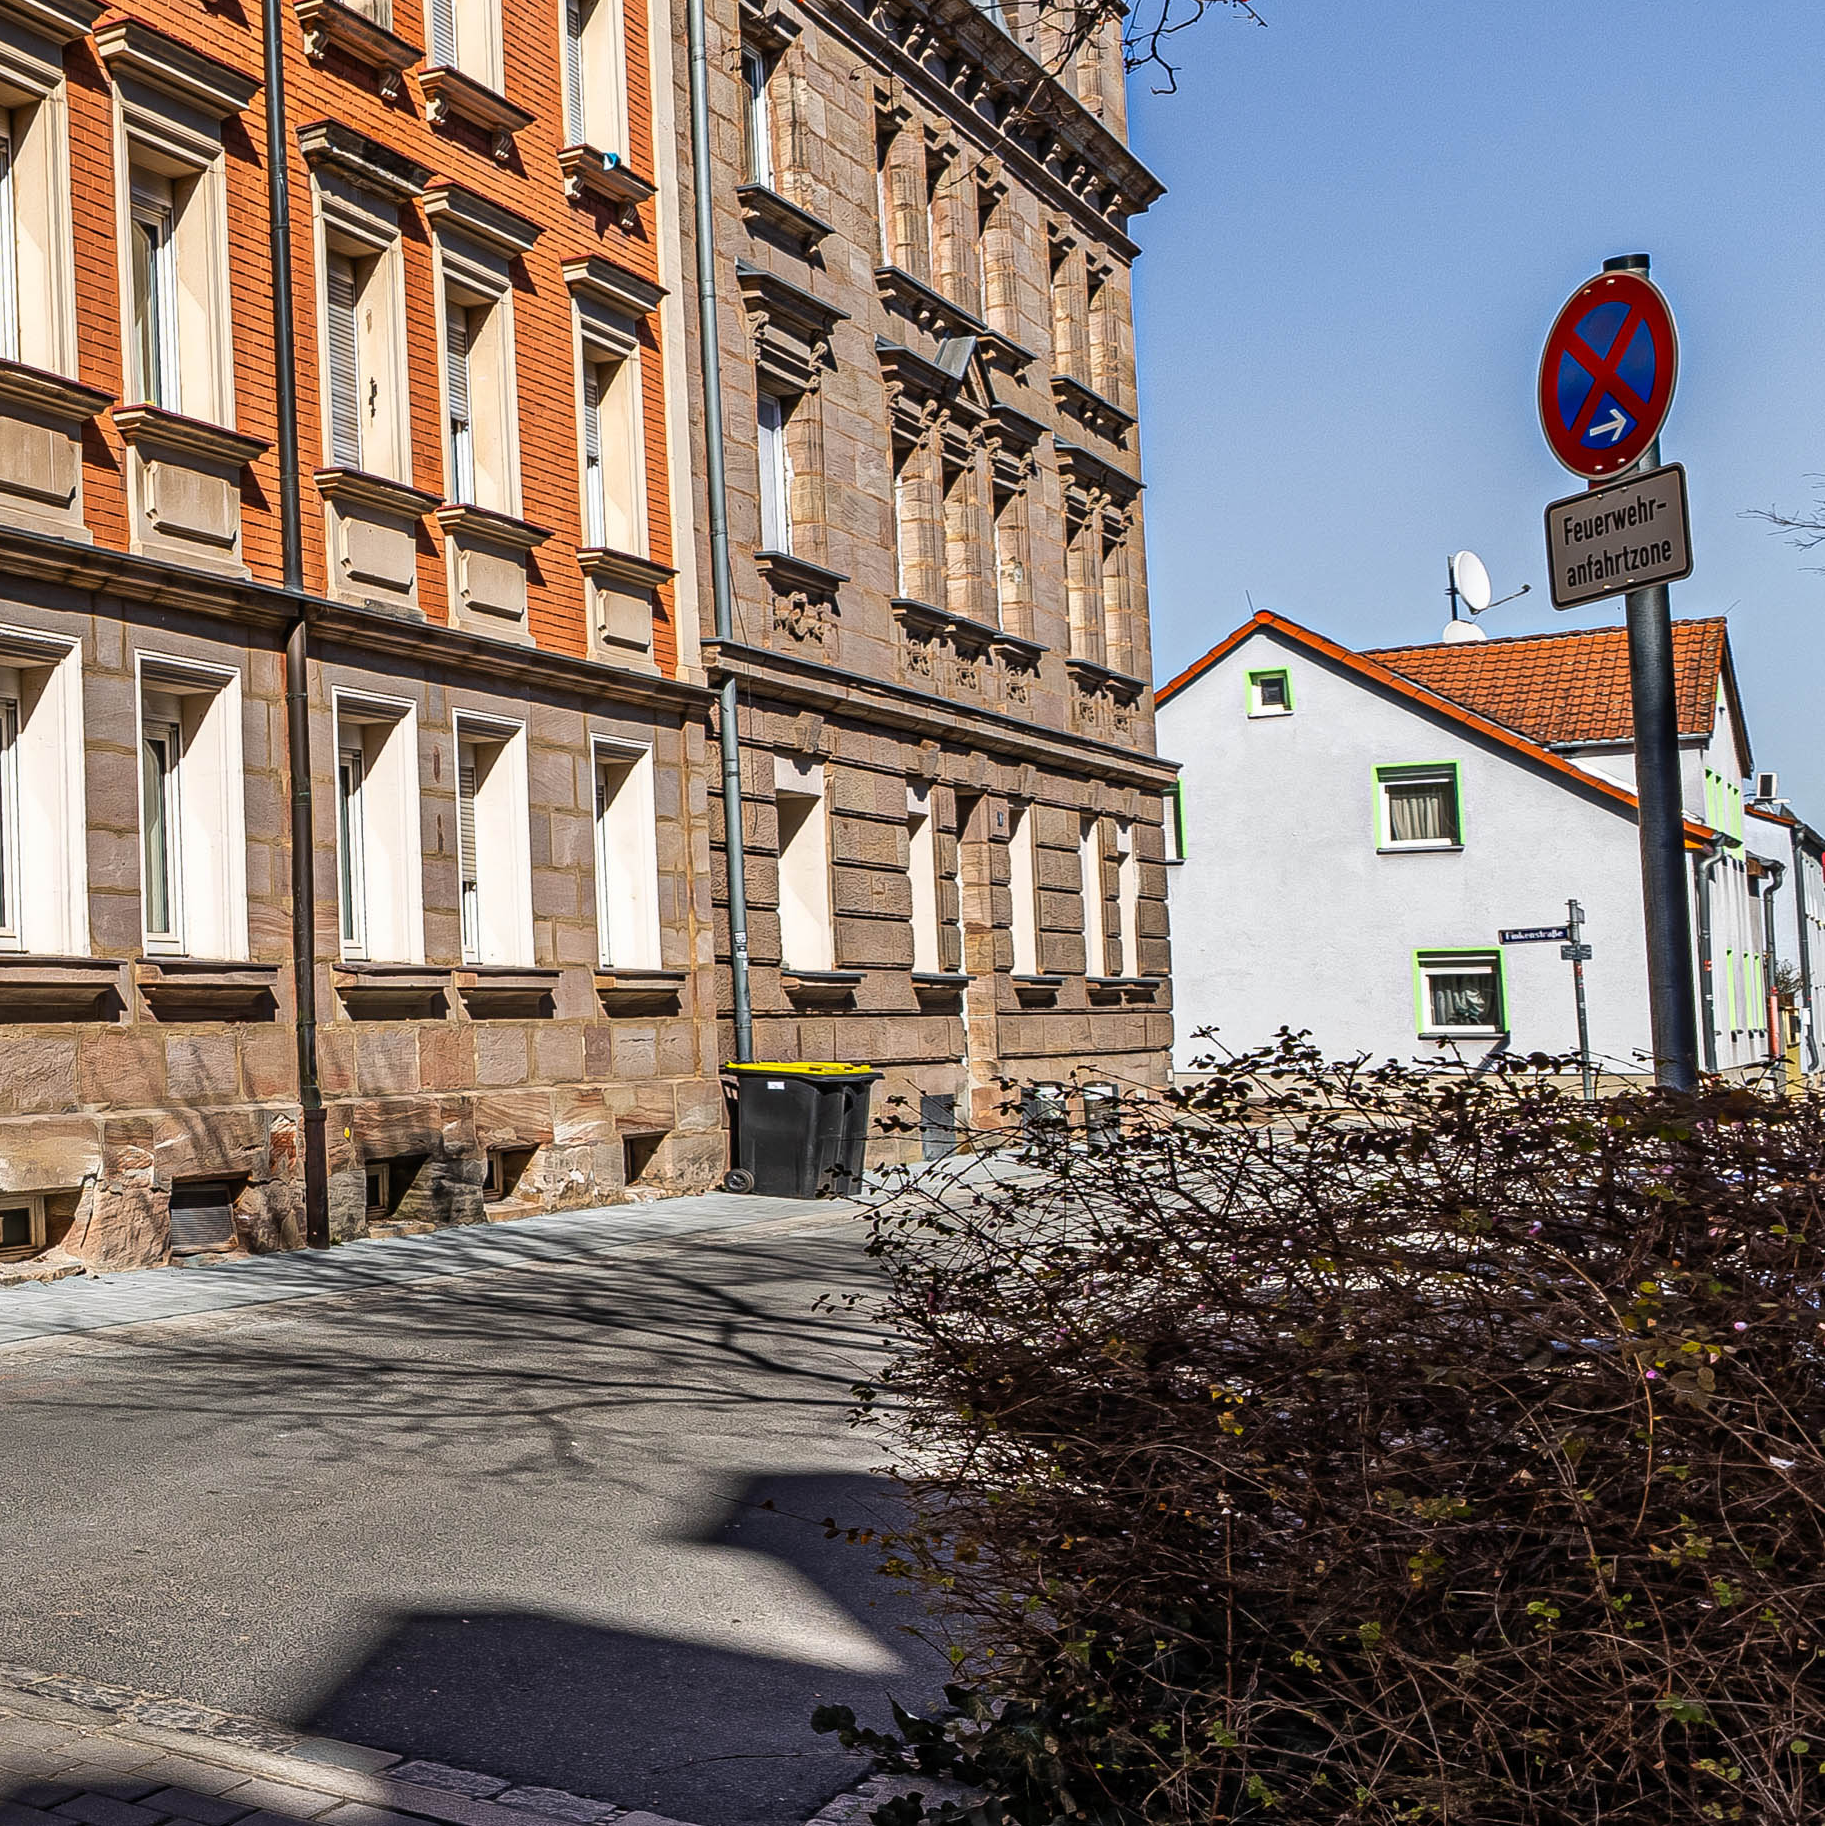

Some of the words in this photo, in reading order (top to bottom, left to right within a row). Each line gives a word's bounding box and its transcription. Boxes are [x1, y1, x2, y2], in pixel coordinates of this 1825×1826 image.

[1563, 494, 1667, 546] Feuerwehr-
[1566, 539, 1672, 587] anfahrtzone
[1505, 928, 1565, 940] Finkenstraße
